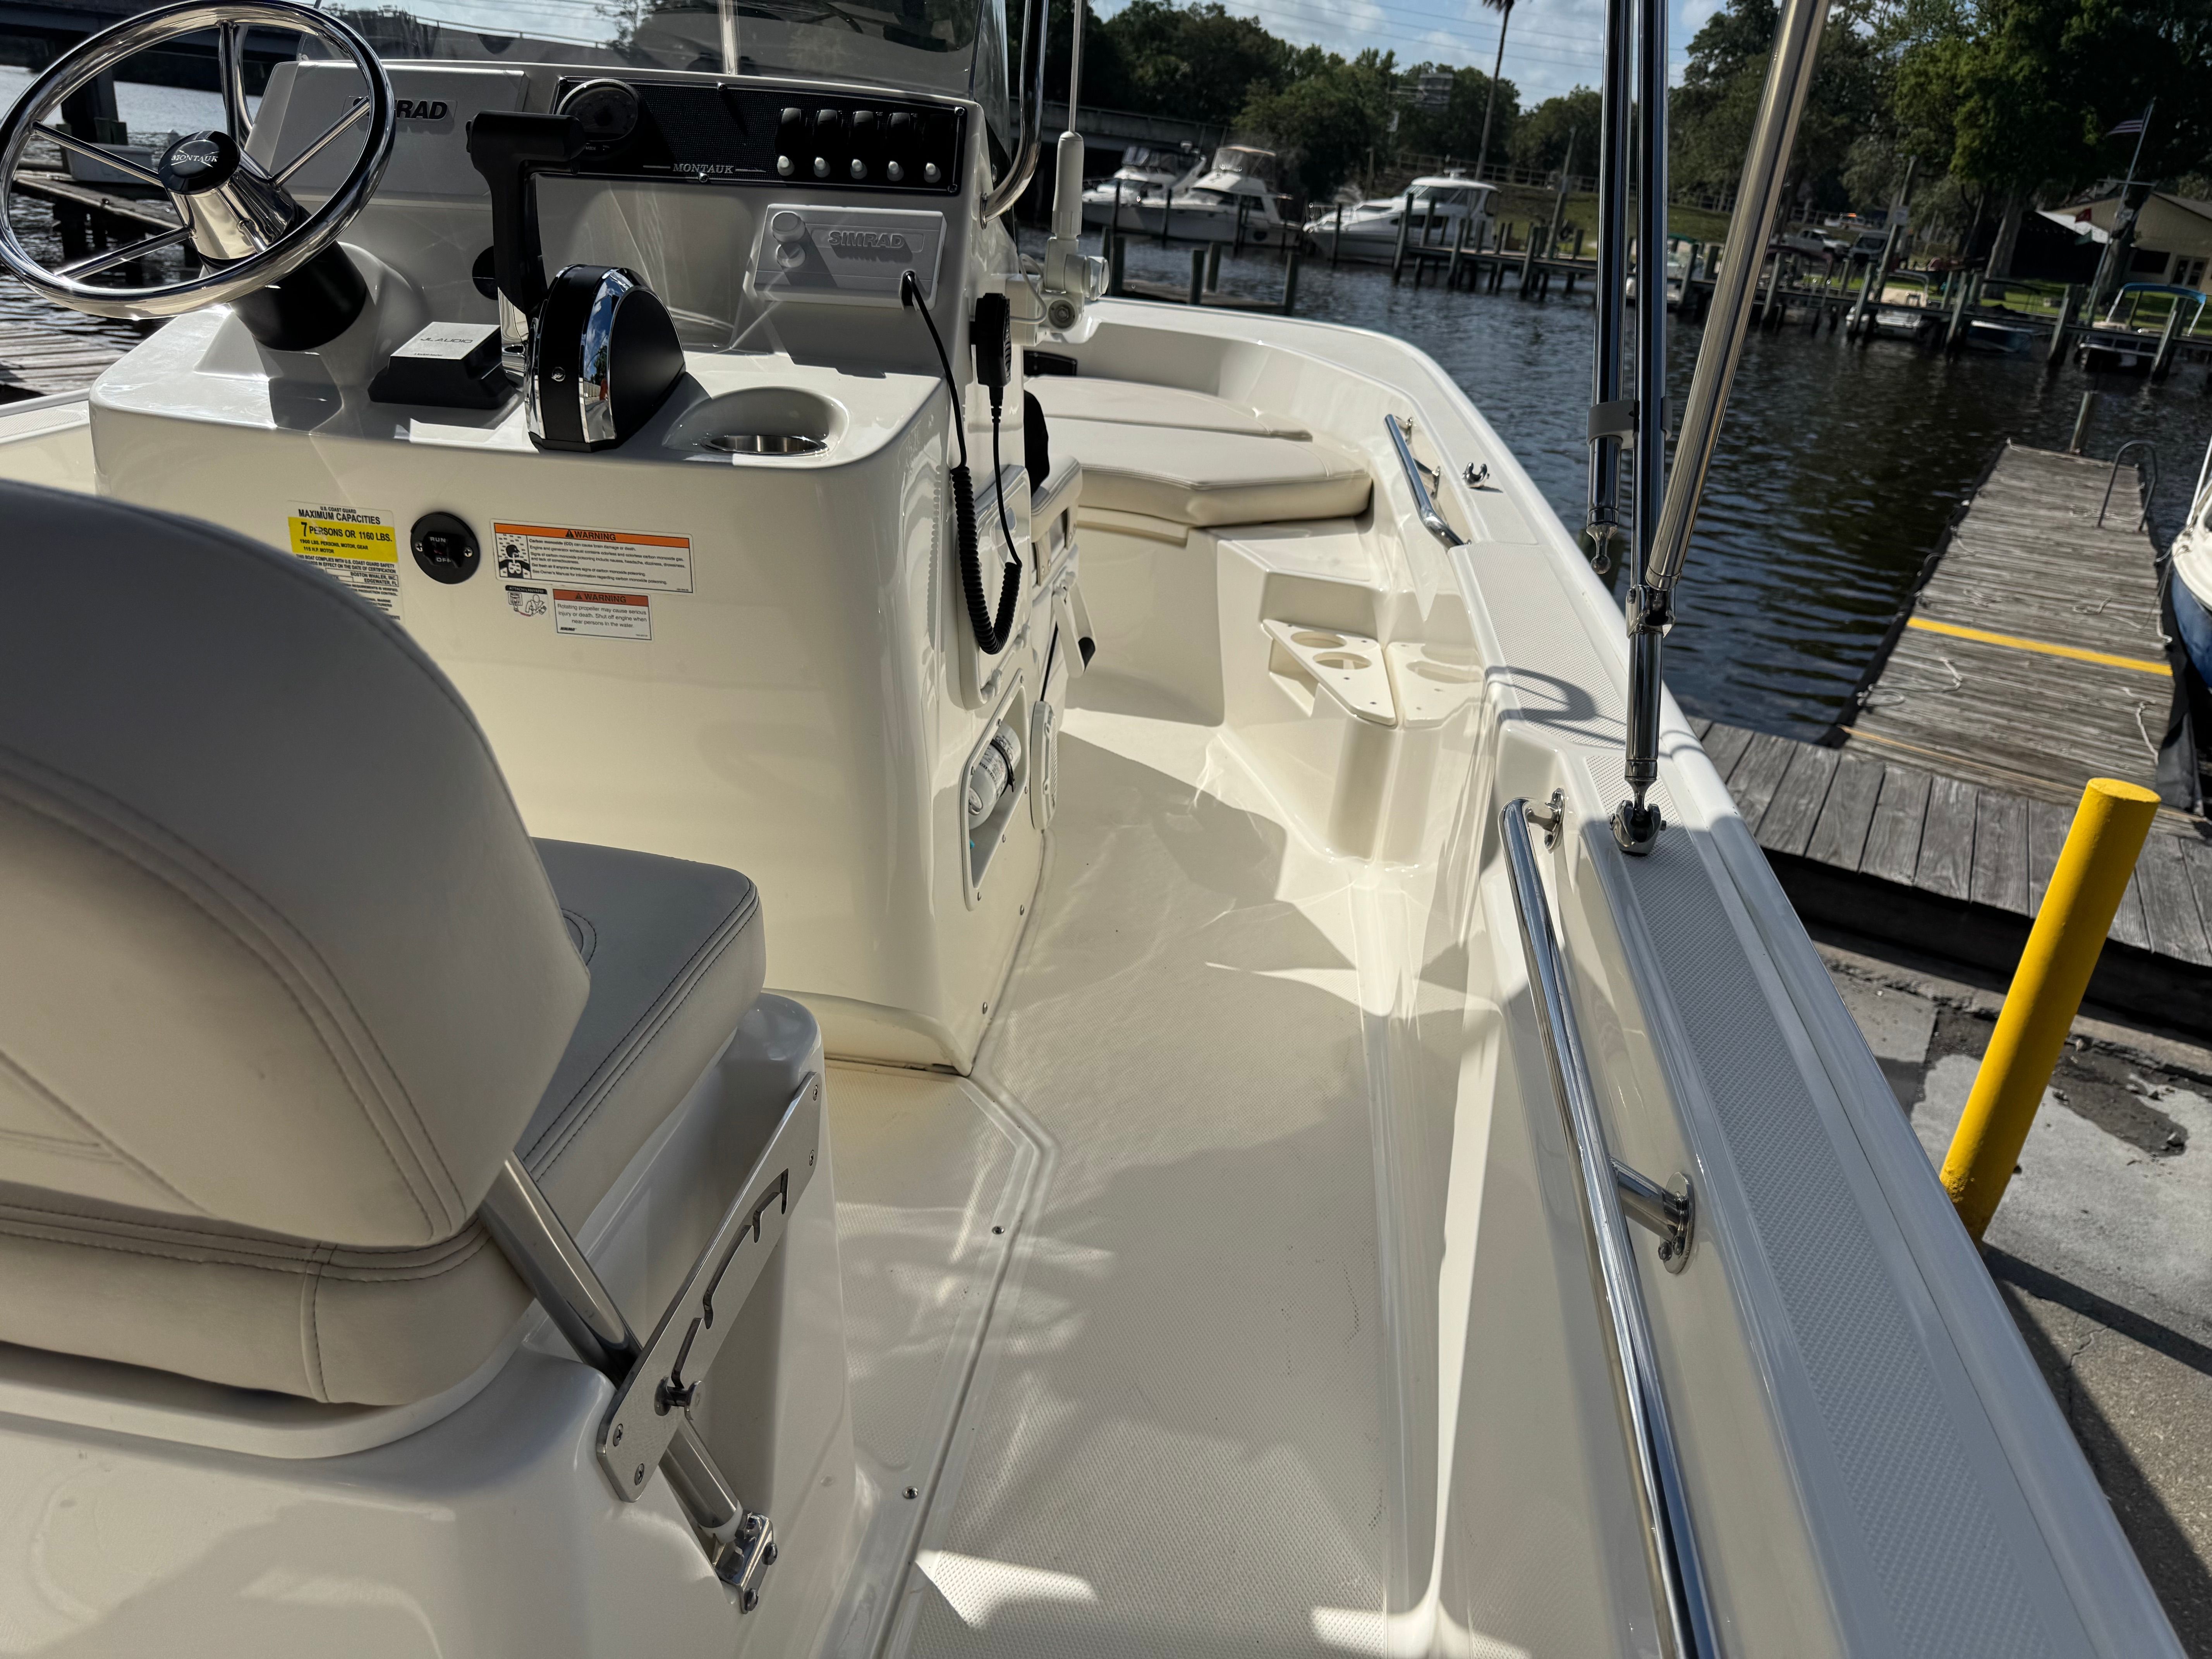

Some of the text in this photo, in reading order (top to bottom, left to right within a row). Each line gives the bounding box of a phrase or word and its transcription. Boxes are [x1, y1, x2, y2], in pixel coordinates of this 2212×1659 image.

[673, 163, 734, 173] MONTAUK
[828, 231, 905, 248] SIMRAD
[299, 509, 381, 525] MAXIMUM CAPACITIES
[301, 521, 392, 542] 7 PERSONS OR 1160 LBS.
[574, 531, 616, 541] WARNING
[584, 593, 626, 603] WARNING
